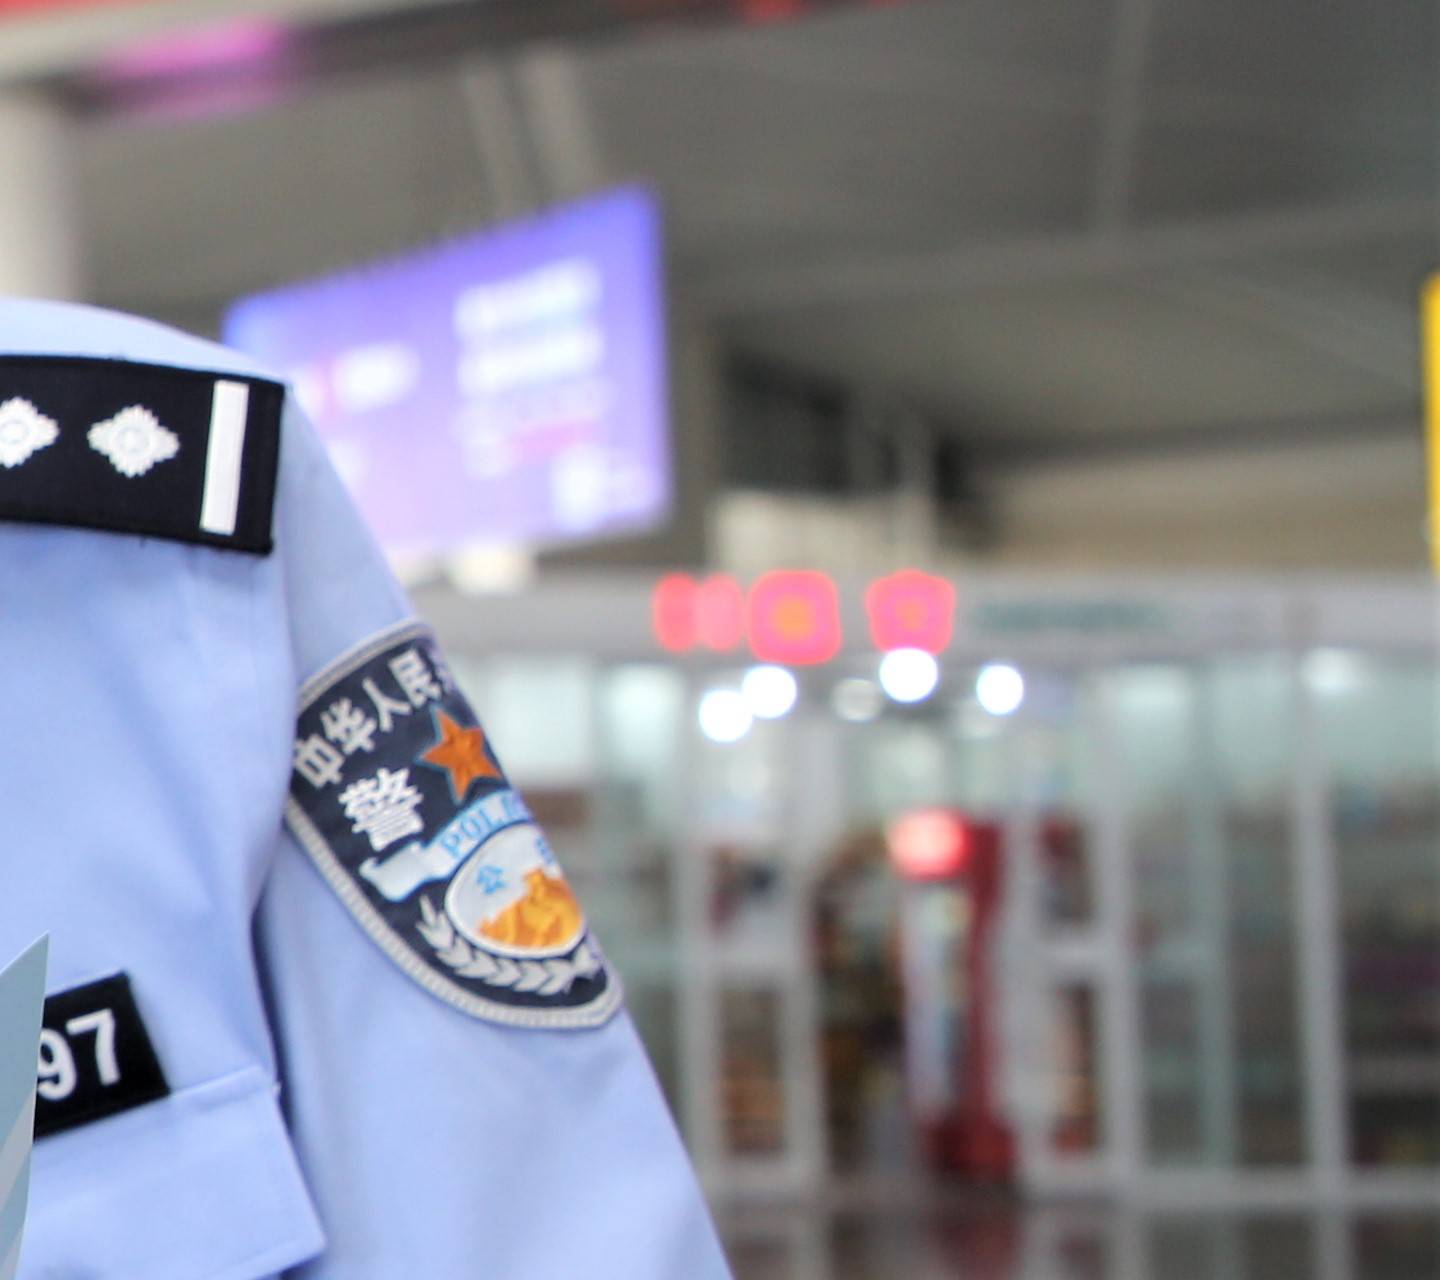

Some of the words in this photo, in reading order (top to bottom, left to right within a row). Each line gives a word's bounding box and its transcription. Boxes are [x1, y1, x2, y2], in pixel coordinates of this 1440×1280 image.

[291, 648, 454, 788] 中华人民
[338, 768, 424, 851] 警
